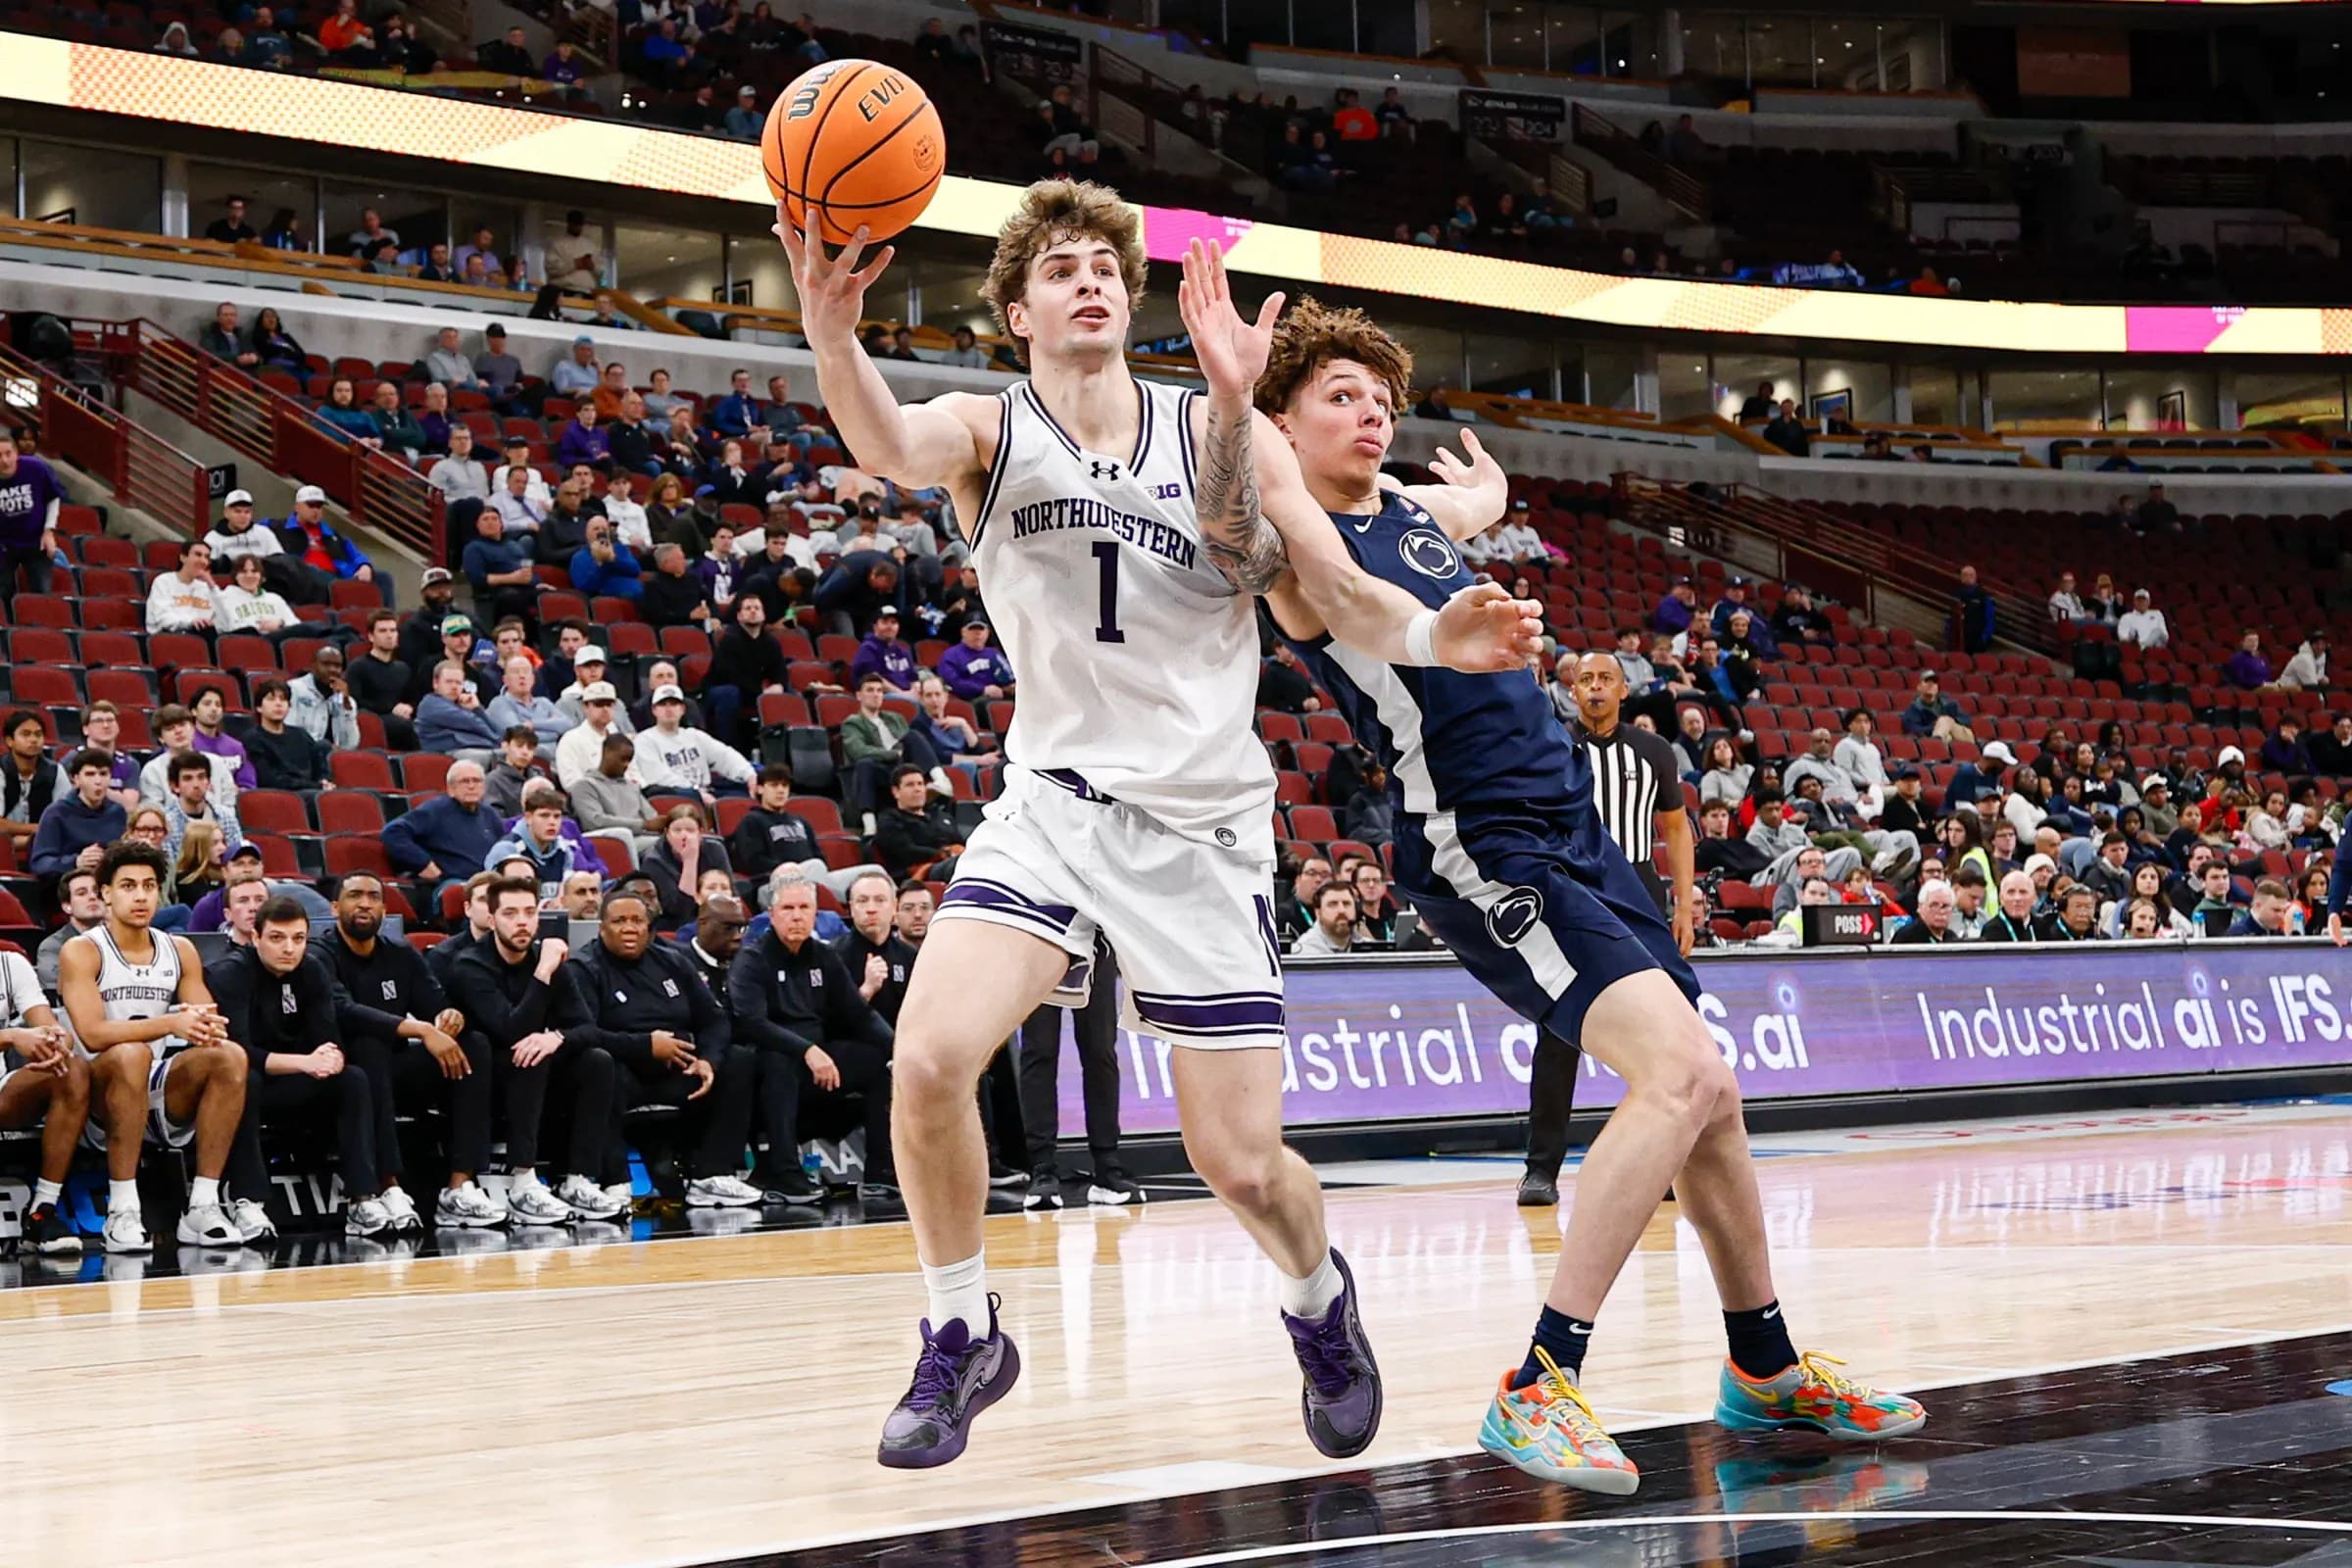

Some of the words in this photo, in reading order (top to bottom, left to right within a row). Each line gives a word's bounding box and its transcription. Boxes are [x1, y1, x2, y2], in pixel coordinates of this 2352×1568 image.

[1011, 498, 1197, 570] NORTHWESTERN
[1092, 541, 1125, 644] 1
[1835, 914, 1863, 934] POSS
[1917, 981, 2165, 1059] Industrial
[2174, 970, 2222, 1050] ai
[2221, 979, 2267, 1045] is
